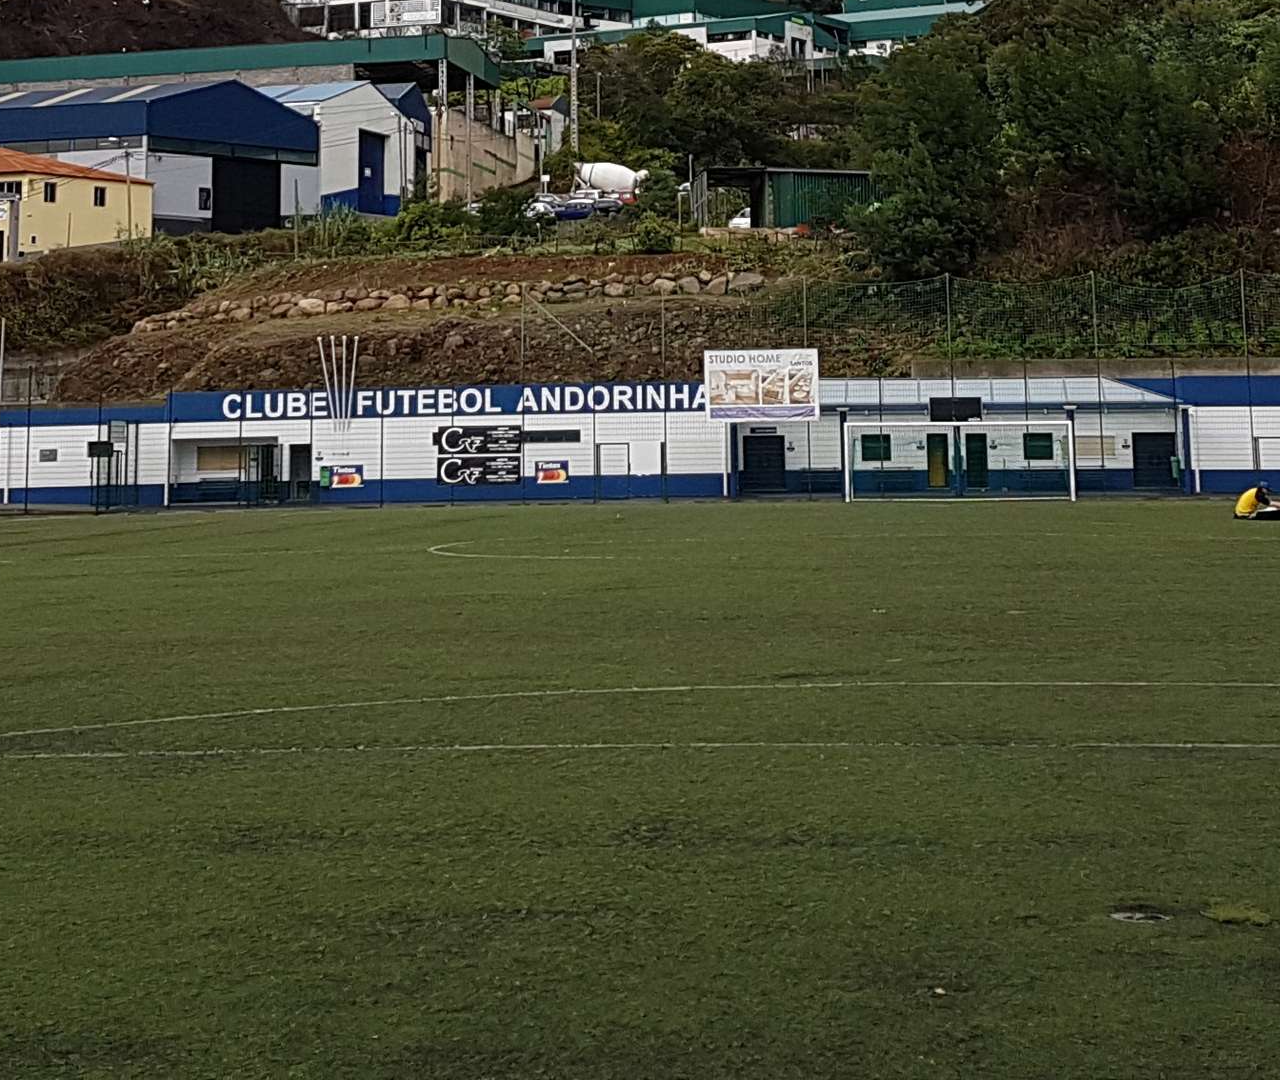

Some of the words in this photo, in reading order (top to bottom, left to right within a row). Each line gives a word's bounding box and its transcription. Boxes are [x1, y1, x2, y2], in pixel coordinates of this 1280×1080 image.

[709, 354, 746, 364] STUDIO
[749, 353, 782, 363] HOME
[222, 391, 328, 419] CLUBE
[356, 388, 502, 416] FUTEBOL
[516, 384, 706, 412] ANDORINHA
